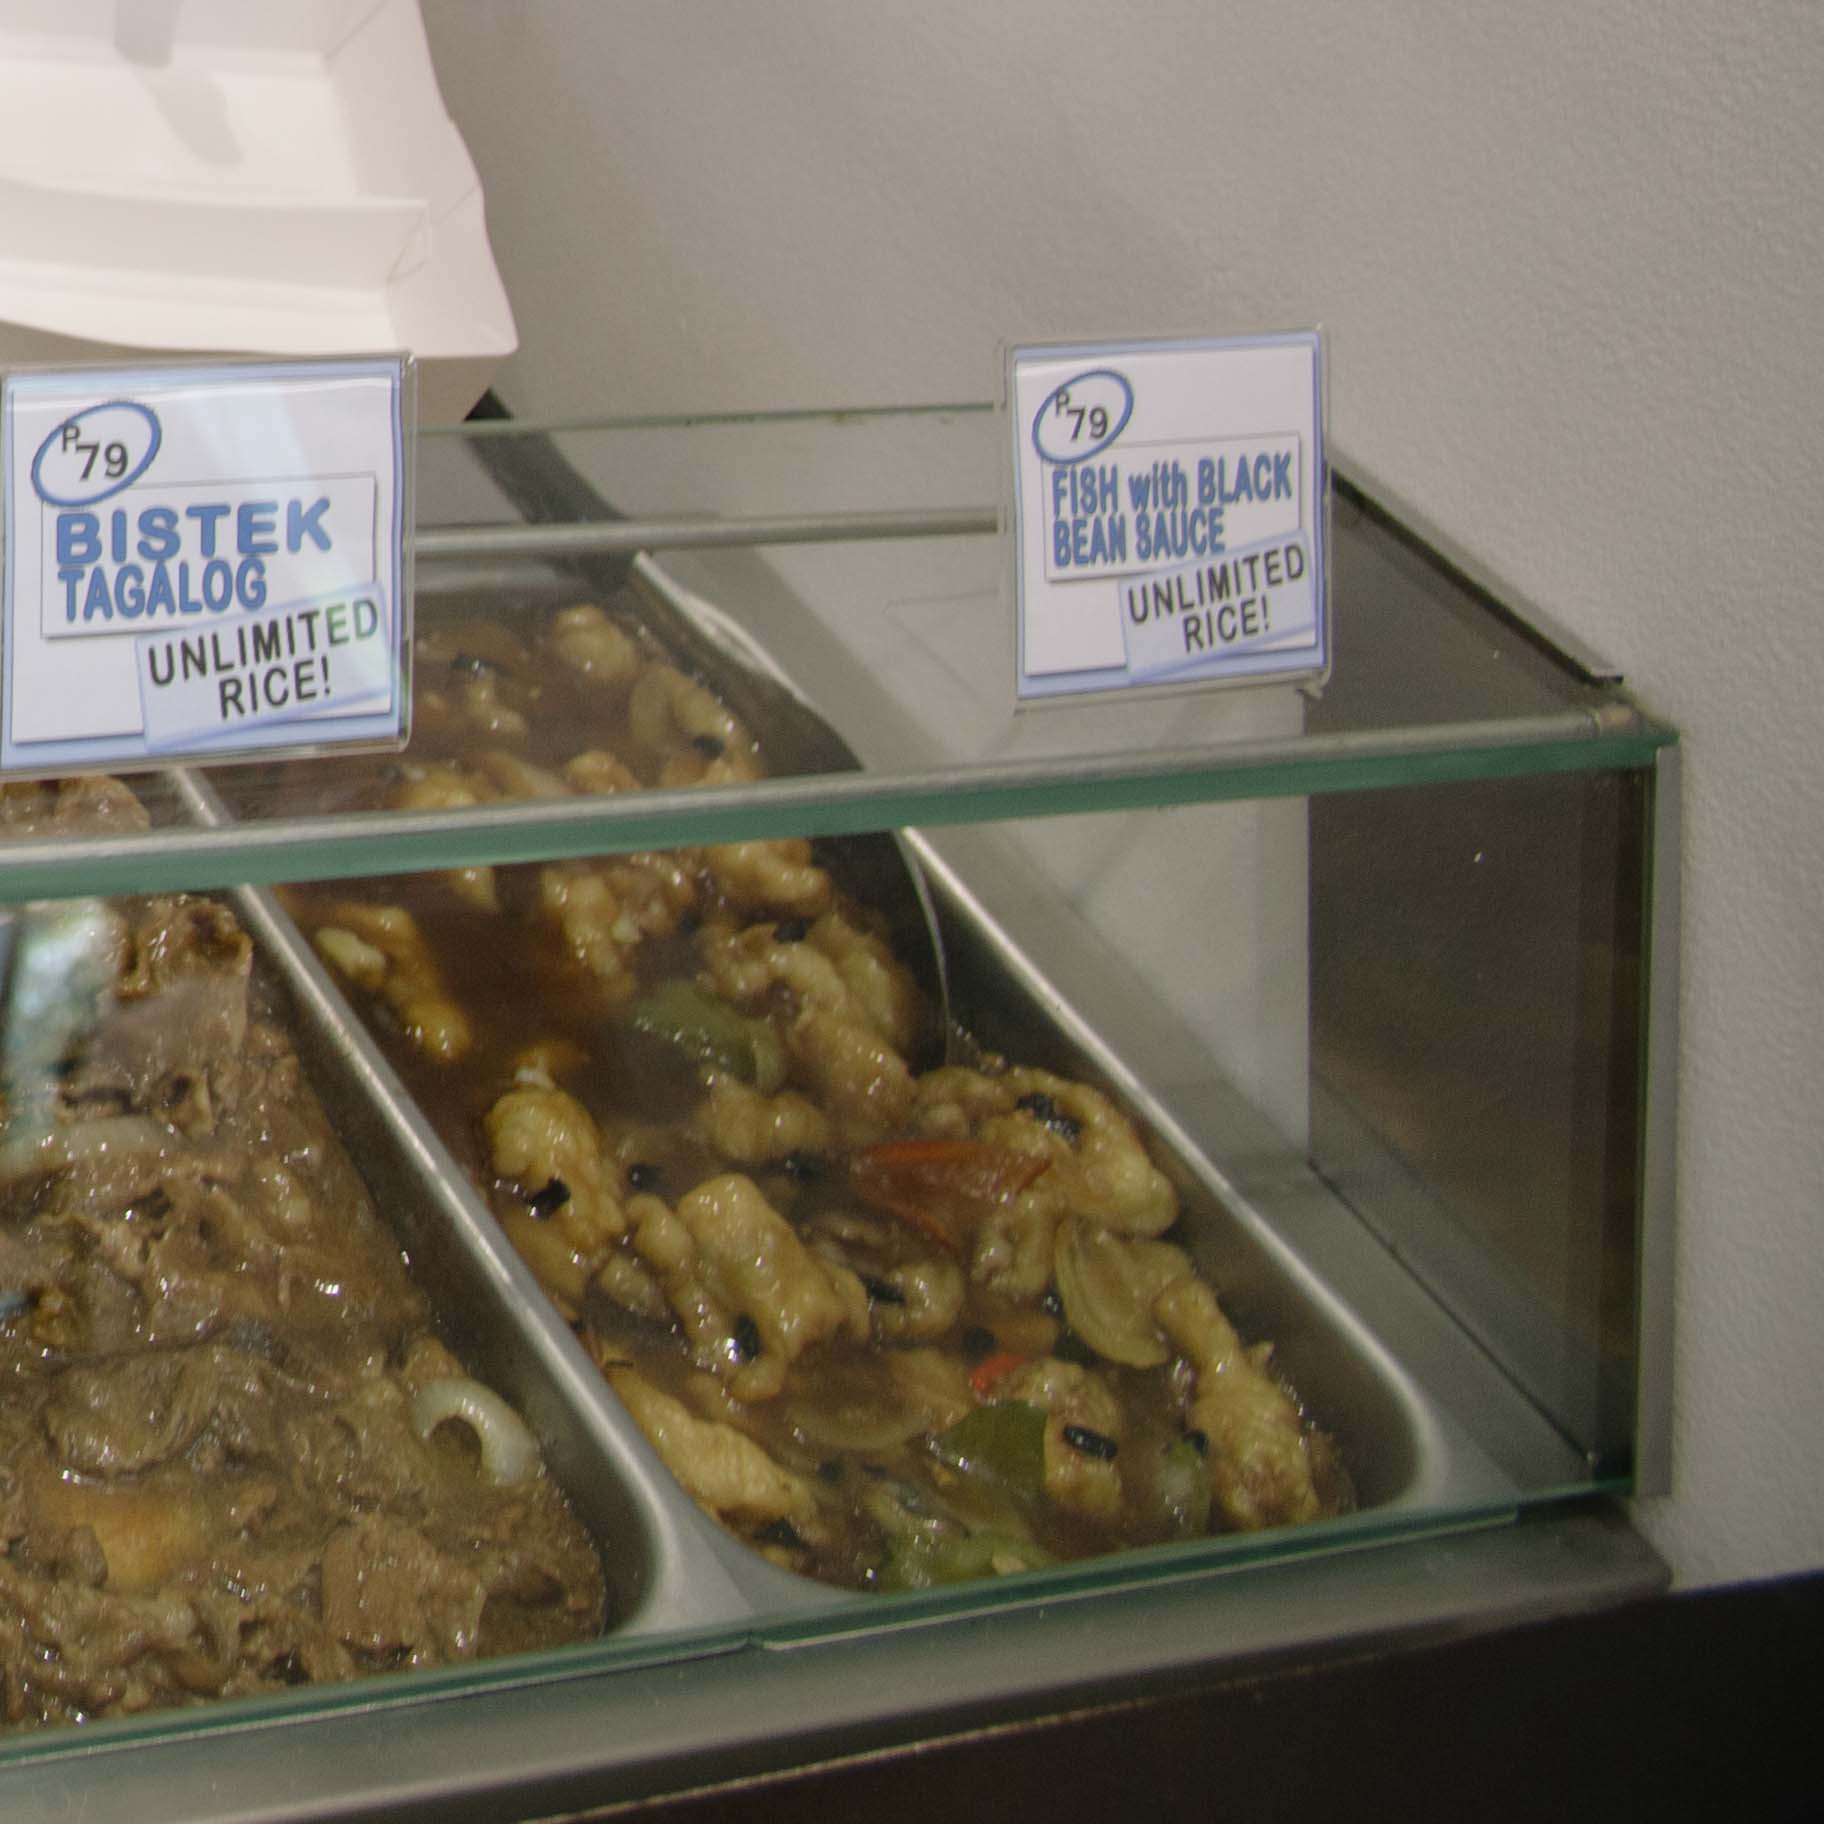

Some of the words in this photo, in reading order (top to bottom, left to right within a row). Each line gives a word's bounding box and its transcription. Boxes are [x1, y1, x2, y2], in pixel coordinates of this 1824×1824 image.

[1051, 461, 1119, 517] FISH
[1128, 460, 1188, 512] with
[1197, 451, 1293, 505] BLACK
[55, 496, 333, 567] BISTEK
[1054, 514, 1126, 568] BEAN
[1135, 506, 1226, 560] SAUCE
[57, 557, 268, 624] TAGALOG
[1128, 544, 1305, 624] UNLIMITED
[148, 598, 379, 687] UNLIMITED
[1183, 595, 1270, 653] RICE!
[218, 656, 332, 720] RICE!
